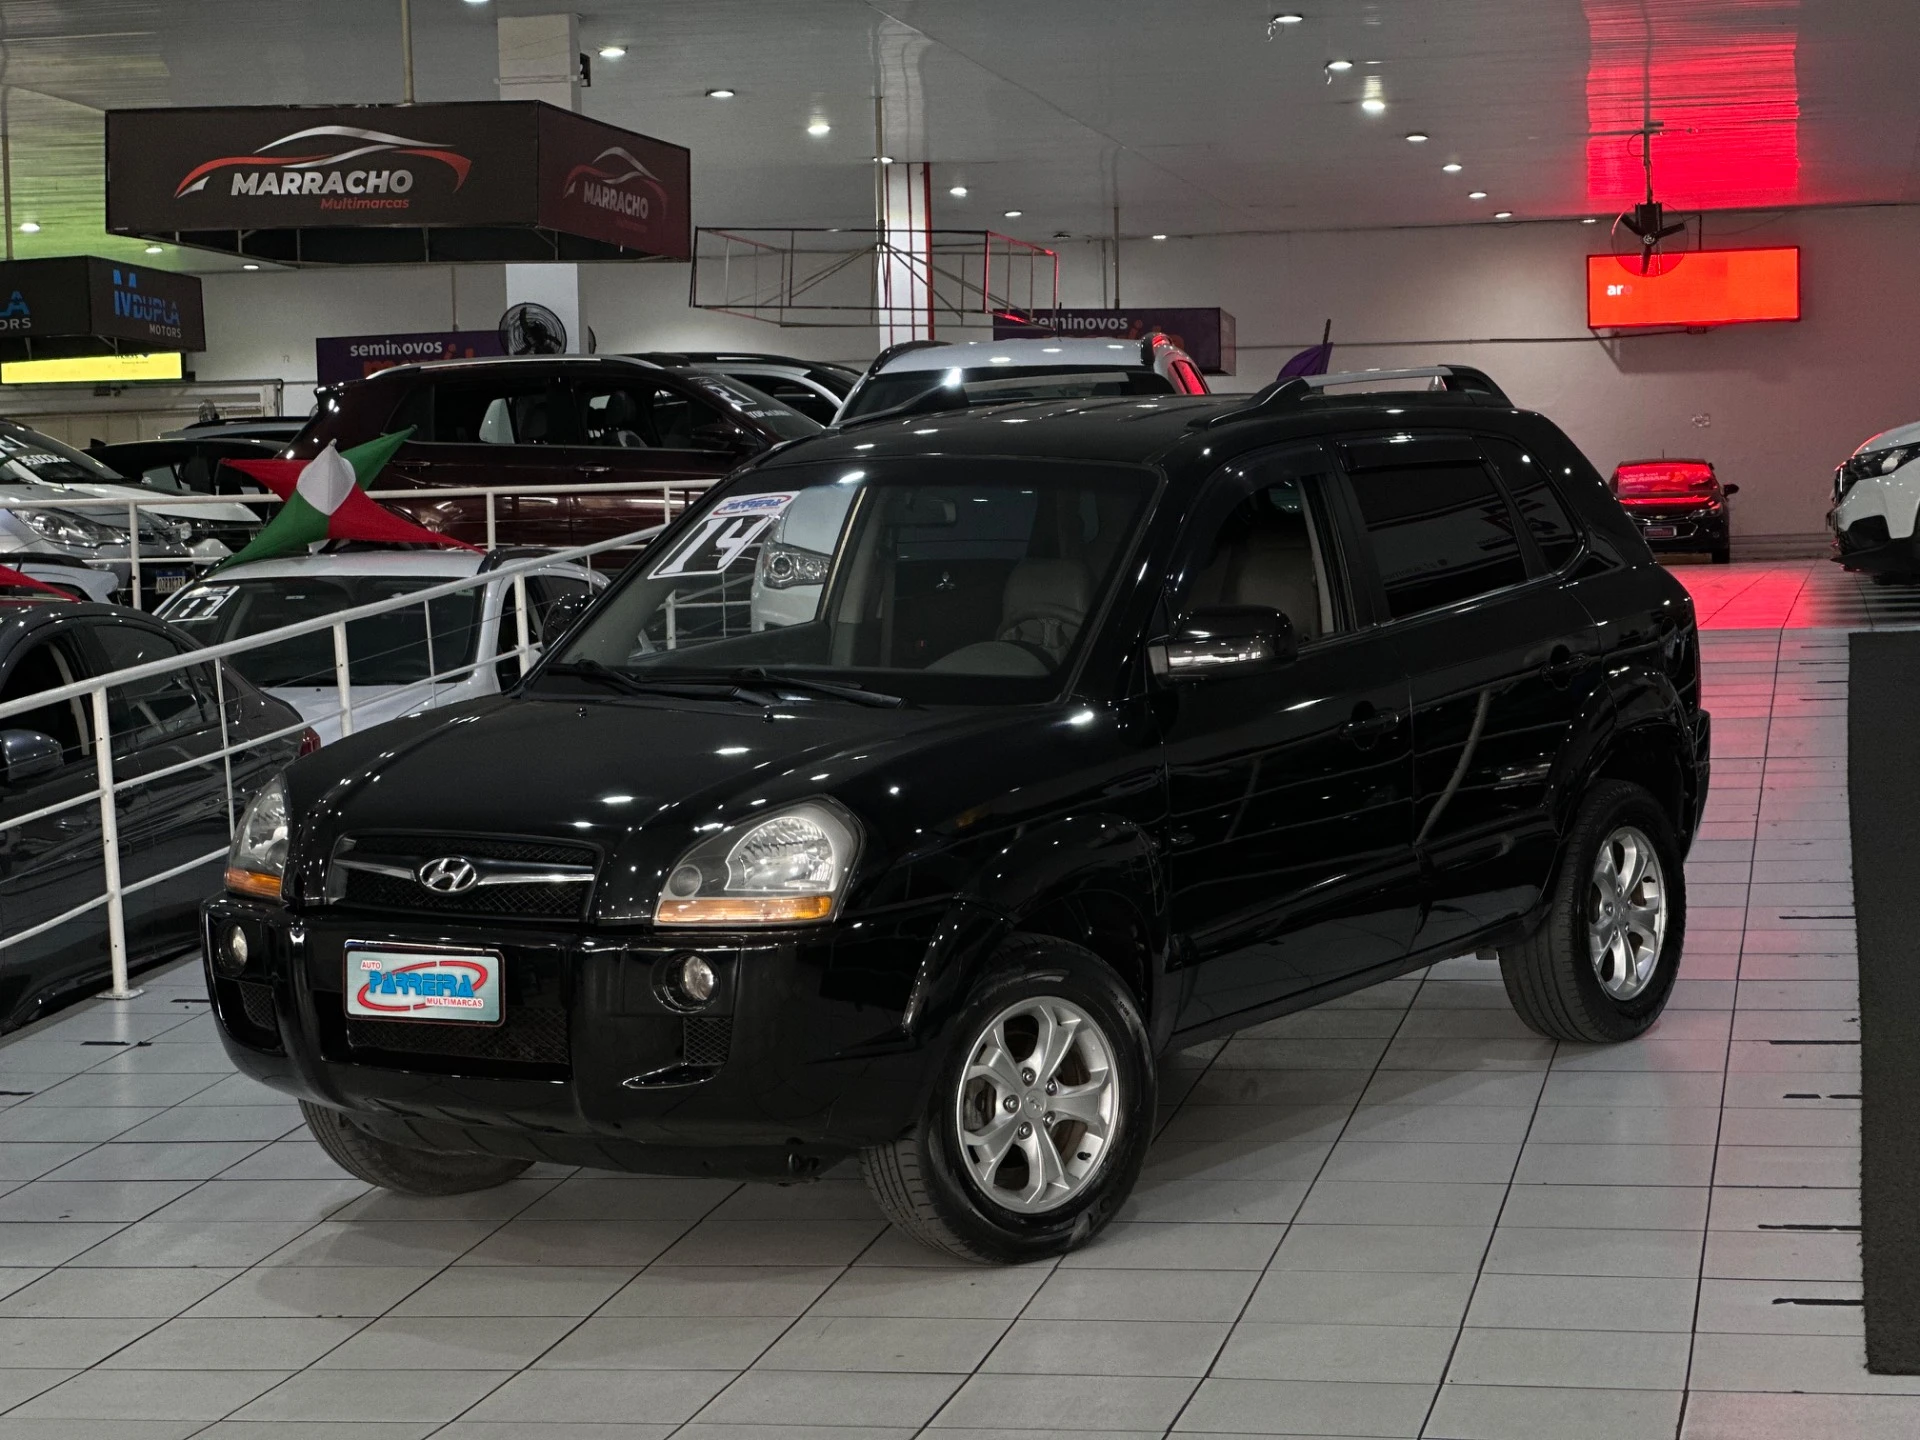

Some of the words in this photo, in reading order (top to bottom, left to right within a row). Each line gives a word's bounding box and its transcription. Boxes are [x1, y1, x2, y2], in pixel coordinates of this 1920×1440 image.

[230, 169, 414, 196] MARRACHO
[320, 196, 410, 211] Multimarcas
[583, 181, 649, 219] MARRACHO
[149, 324, 182, 339] MOTORS
[350, 339, 443, 357] seminovos
[658, 517, 770, 575] 14
[179, 596, 224, 618] 17
[361, 961, 381, 970] AUTO
[369, 970, 475, 998] PARREIRA
[426, 997, 483, 1007] MULTIMARCAS
